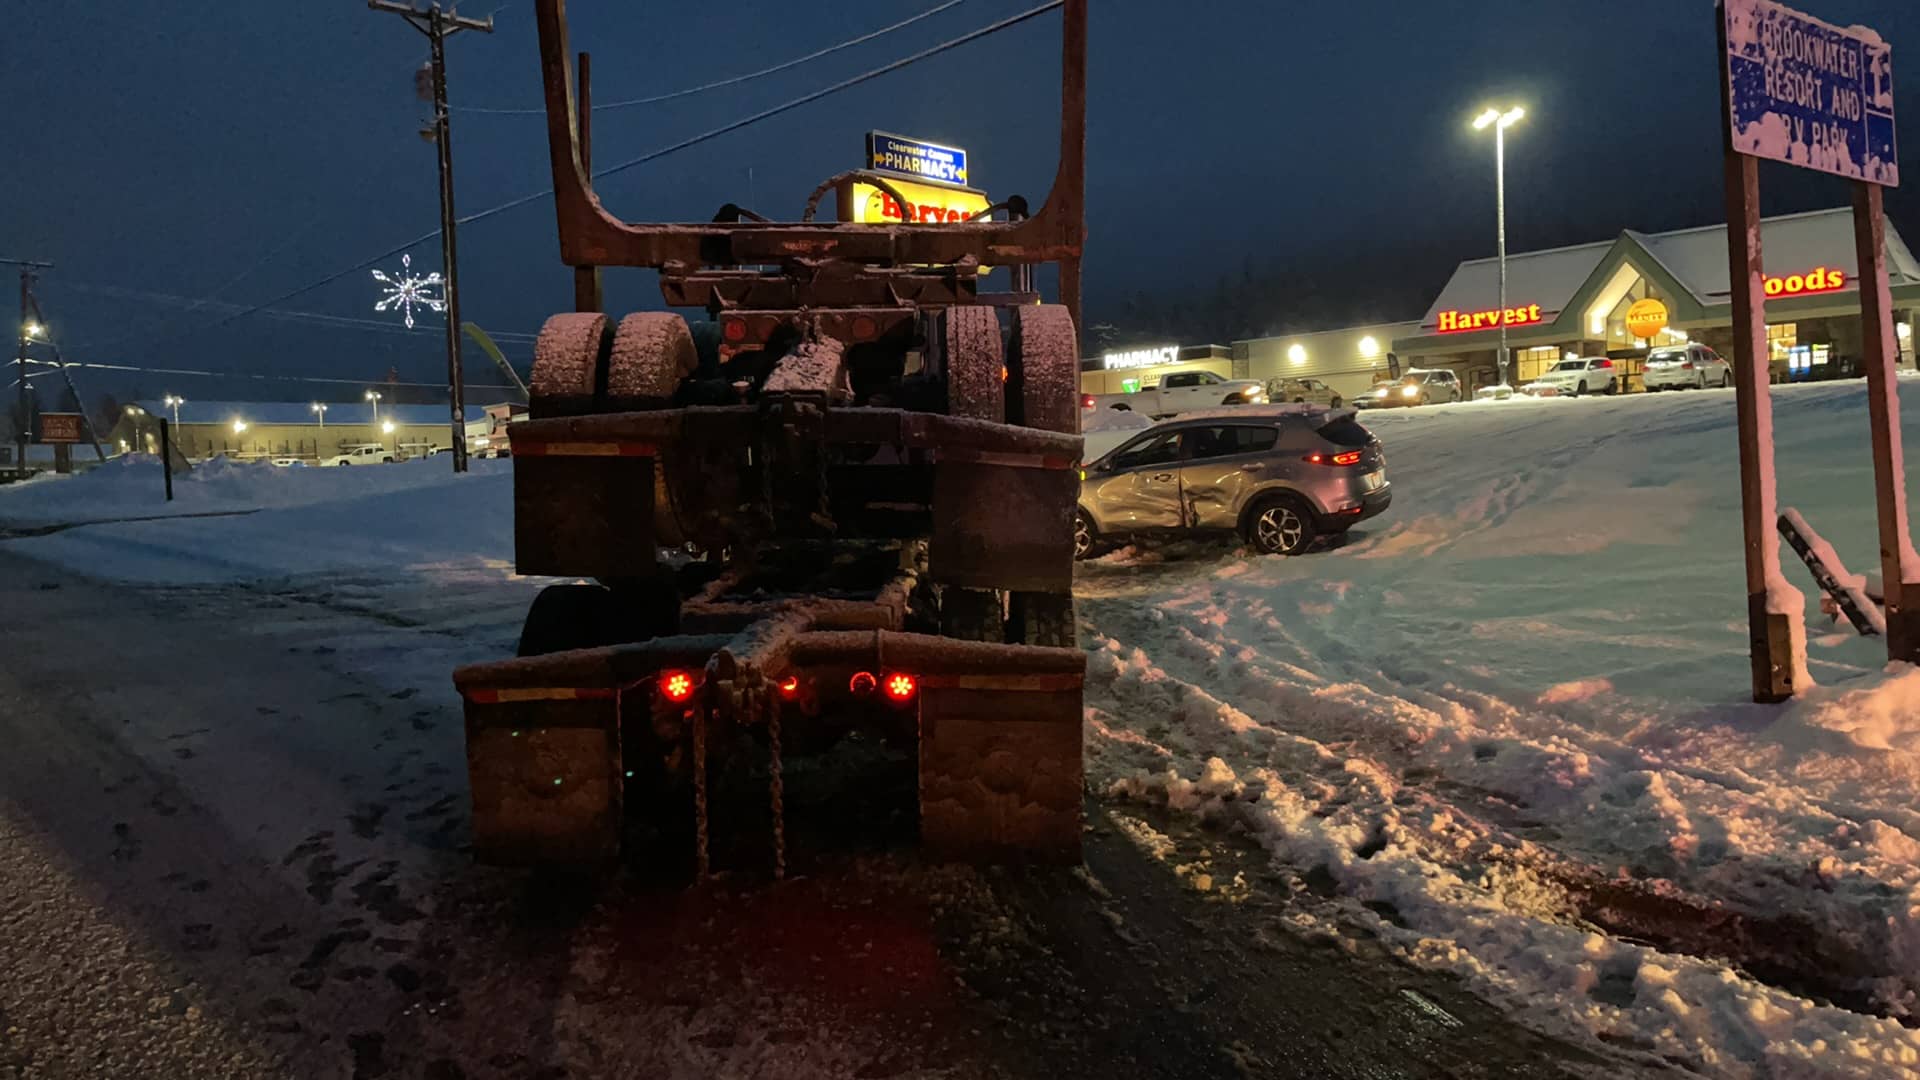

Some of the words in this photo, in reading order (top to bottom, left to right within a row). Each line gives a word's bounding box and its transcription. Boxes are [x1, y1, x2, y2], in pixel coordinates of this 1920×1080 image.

[1763, 19, 1858, 80] BROOKWATER
[1764, 66, 1822, 110] RESORT
[1832, 86, 1860, 122] AND
[888, 141, 926, 156] Clearwater
[1812, 122, 1849, 150] PARK
[886, 152, 956, 179] PHARMACY
[1439, 304, 1541, 330] Harvest
[1762, 267, 1843, 294] oods
[1105, 346, 1179, 370] PHARMACY
